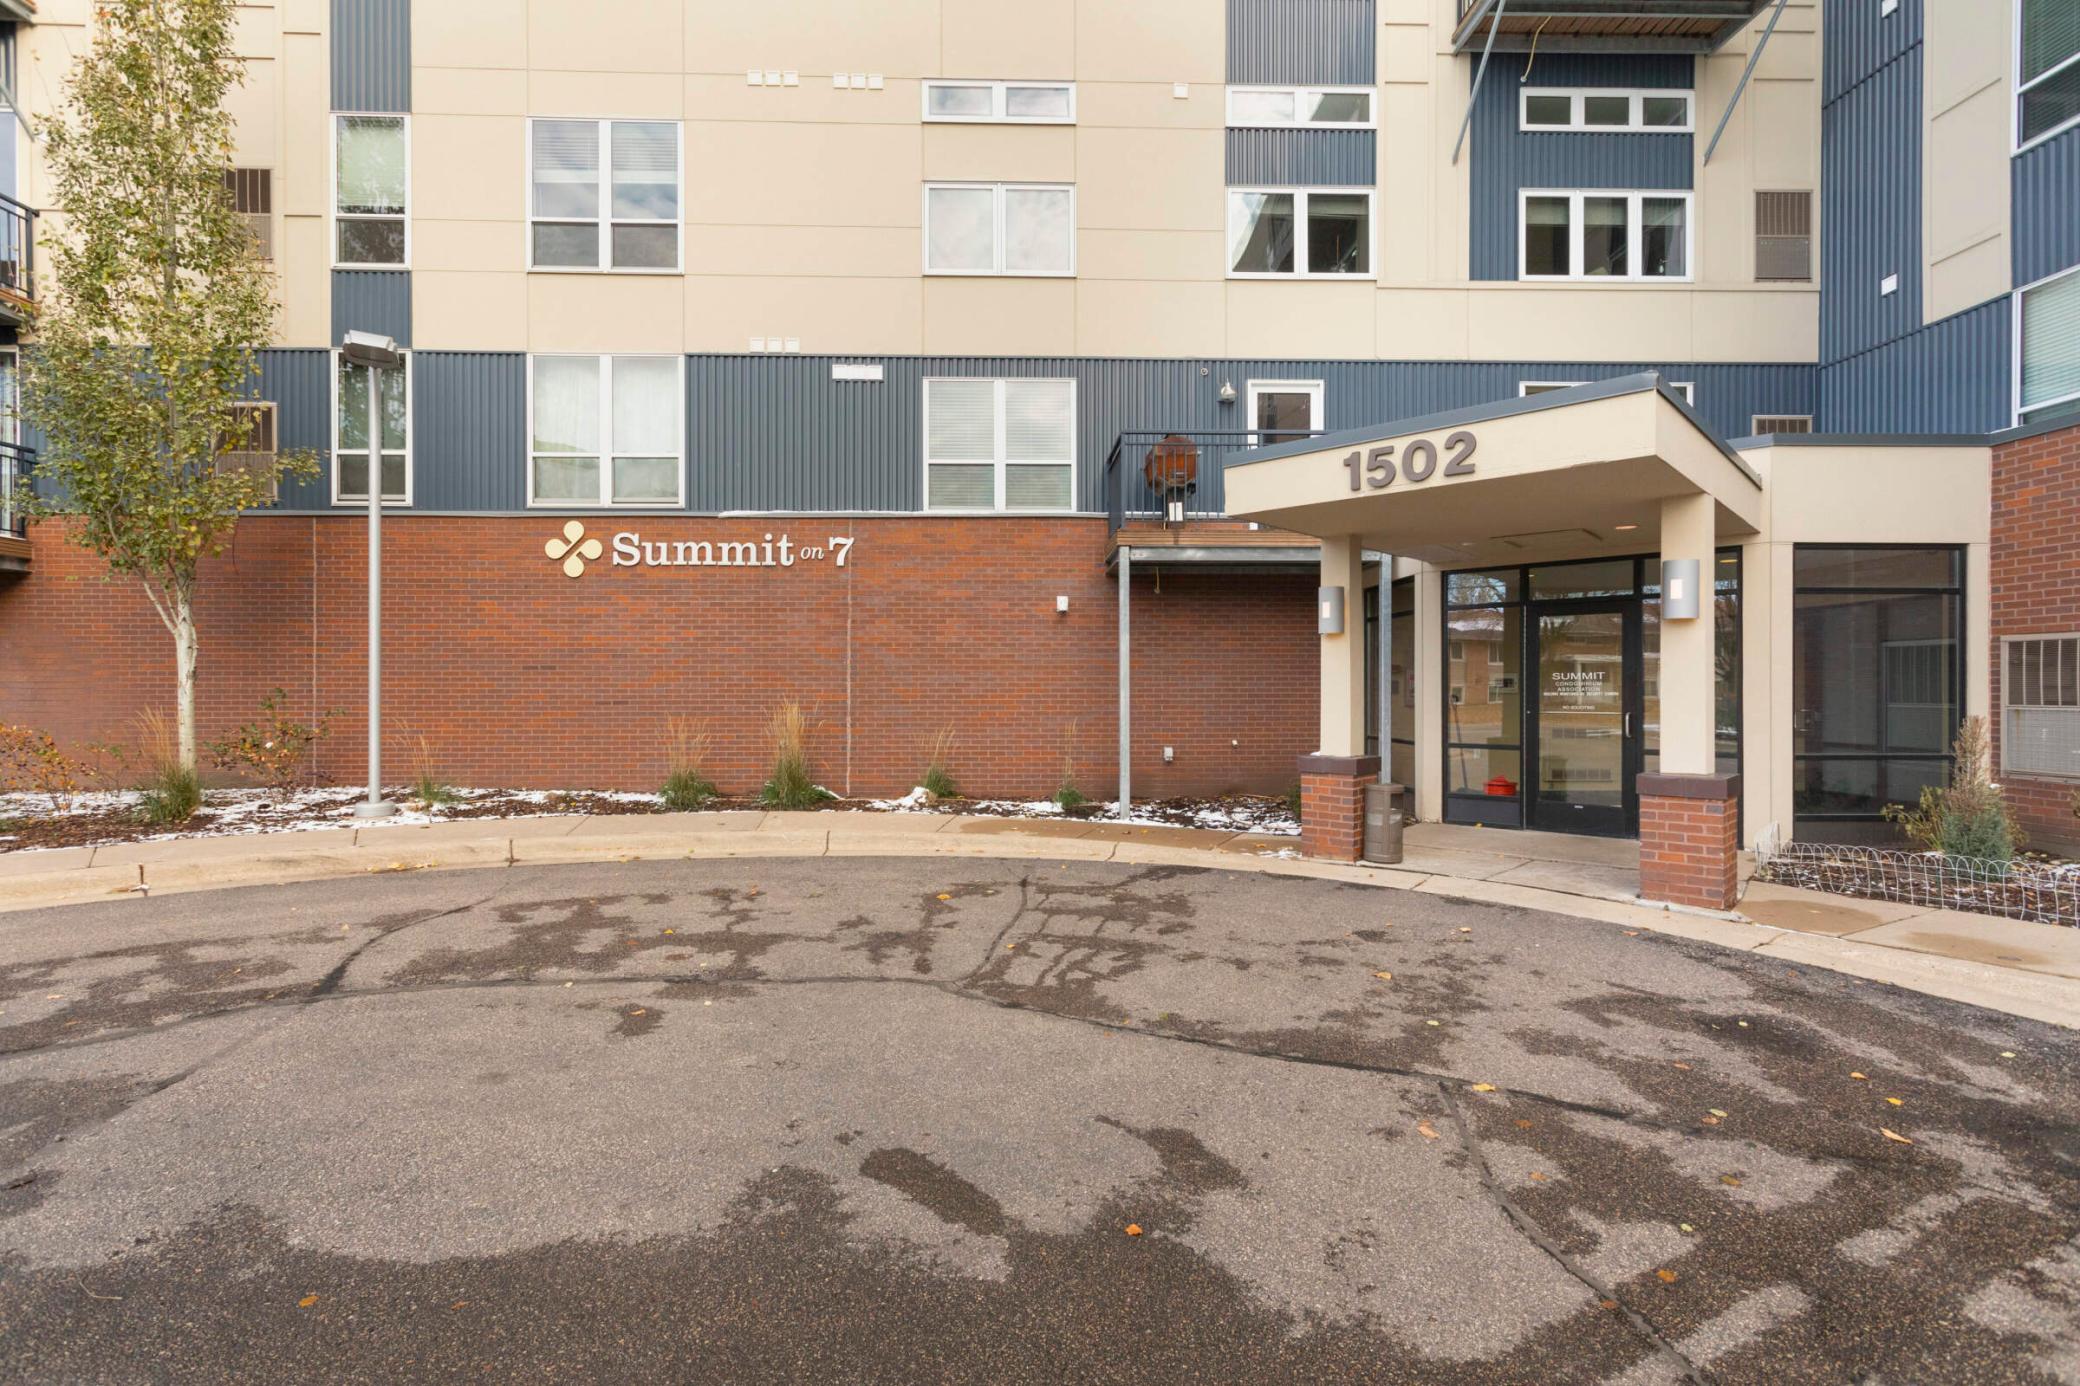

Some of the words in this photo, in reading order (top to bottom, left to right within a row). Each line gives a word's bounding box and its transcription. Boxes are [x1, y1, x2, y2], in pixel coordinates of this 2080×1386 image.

[1343, 431, 1477, 491] 1502
[612, 532, 794, 567] Summit
[800, 546, 824, 560] on
[828, 536, 854, 567] 7
[1552, 671, 1605, 680] SUMMIT
